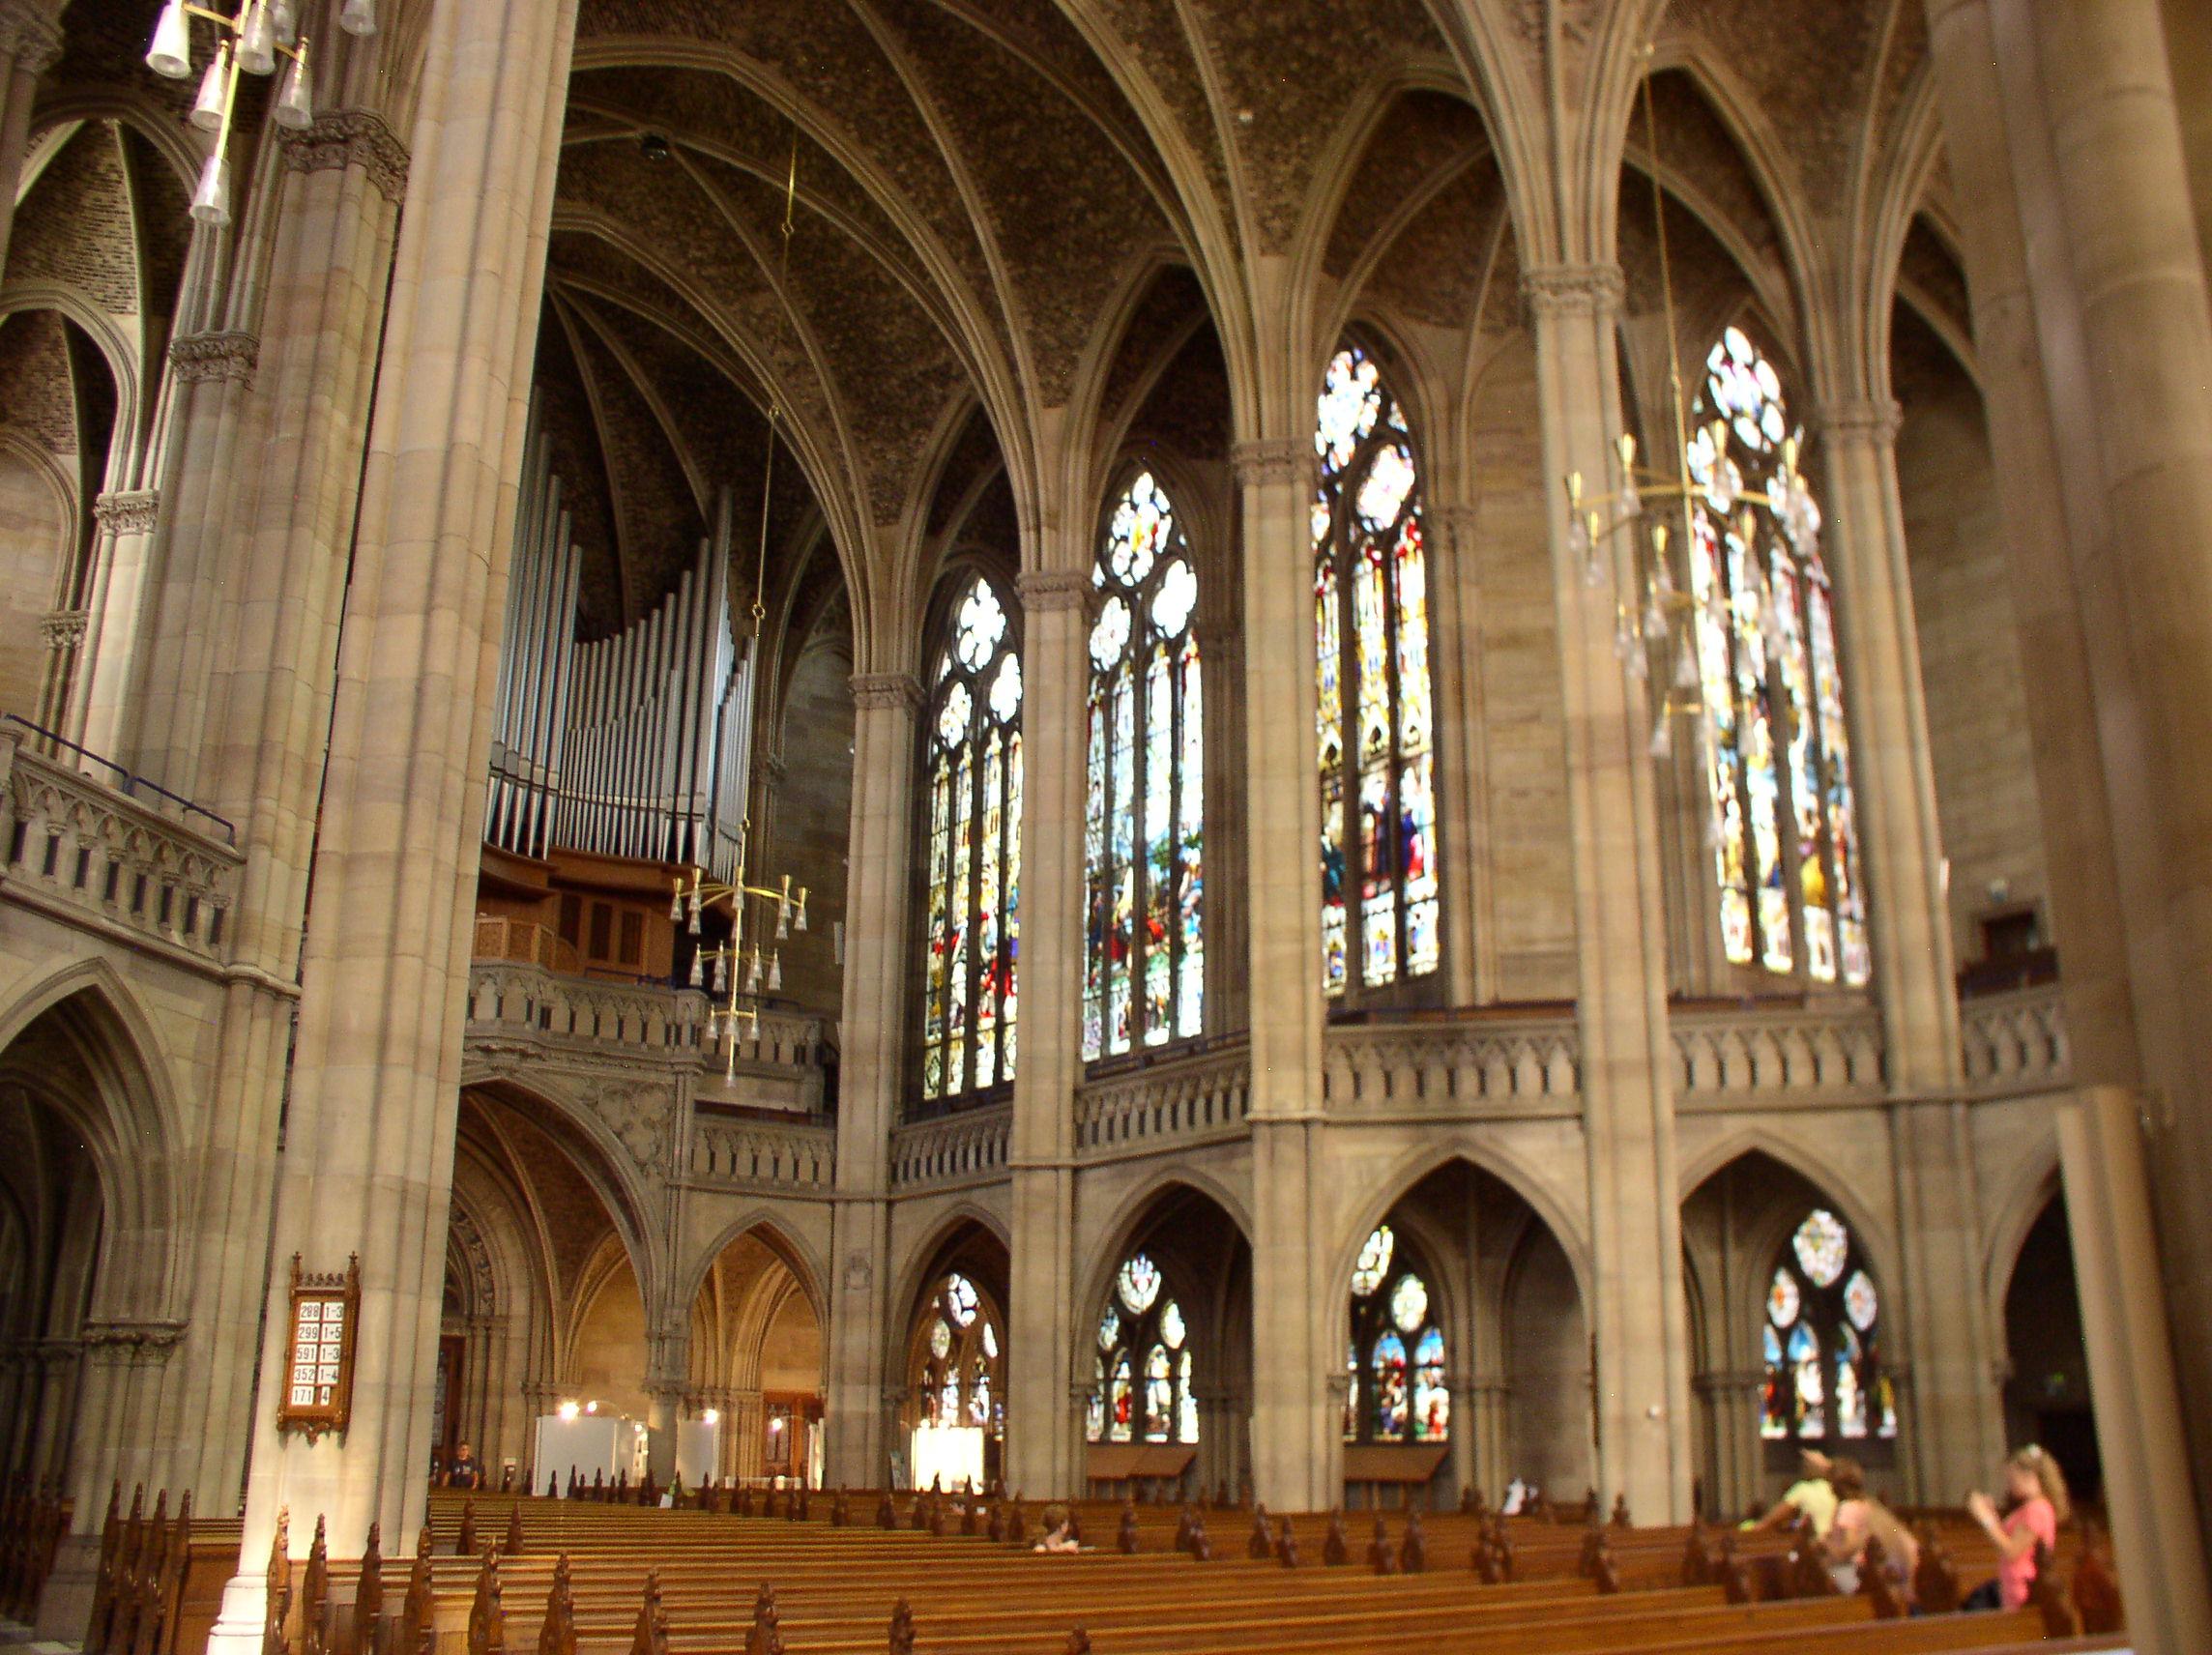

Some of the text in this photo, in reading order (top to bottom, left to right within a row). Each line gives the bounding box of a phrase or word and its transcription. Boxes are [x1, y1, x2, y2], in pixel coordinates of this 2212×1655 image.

[326, 1306, 343, 1318] 1-3
[299, 1326, 318, 1339] 299
[297, 1347, 340, 1360] 591 1-3
[294, 1368, 337, 1380] 352 1-4
[294, 1389, 328, 1402] 171 4
